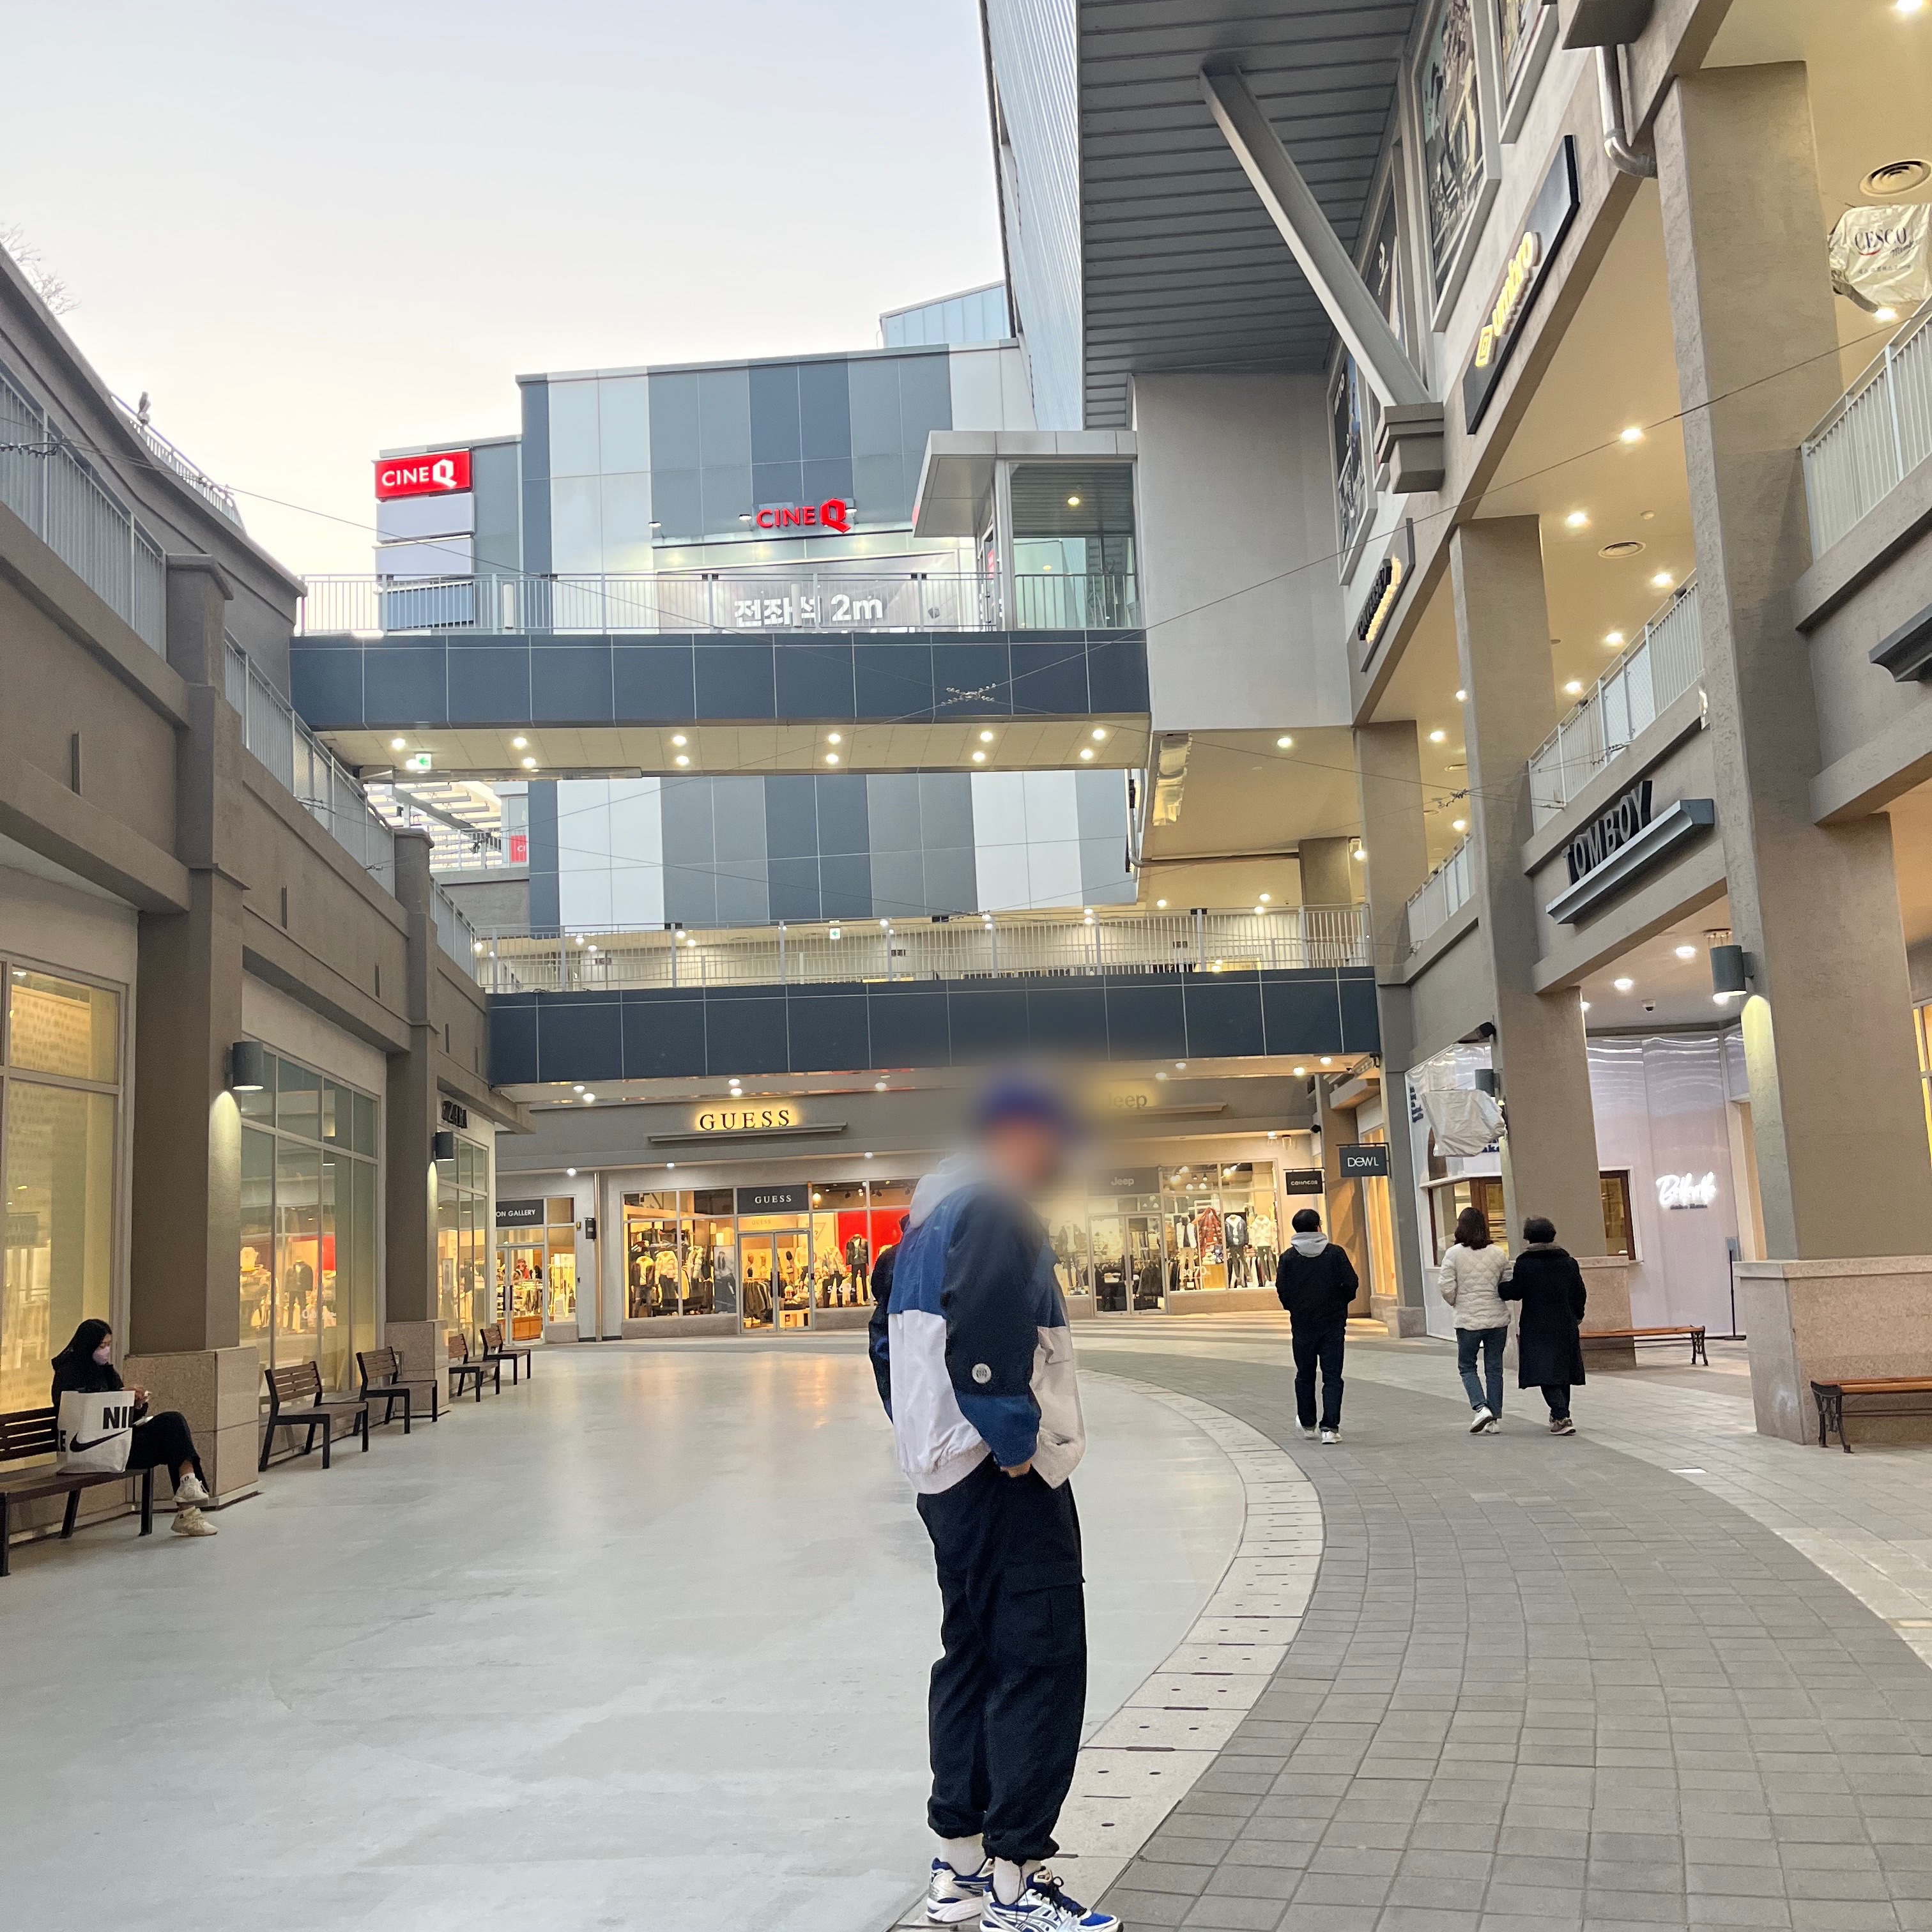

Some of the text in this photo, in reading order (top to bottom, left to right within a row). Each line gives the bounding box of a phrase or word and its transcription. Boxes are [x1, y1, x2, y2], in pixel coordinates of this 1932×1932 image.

[1854, 227, 1906, 250] CESCO
[381, 459, 457, 488] CINE Q
[756, 498, 852, 533] CINE Q
[831, 594, 884, 622] 2m
[1561, 780, 1653, 887] TOMBOY
[700, 1110, 790, 1130] GUESS
[1110, 1176, 1135, 1186] Jeep
[755, 1195, 792, 1204] GUESS
[508, 1209, 536, 1217] GALLERY
